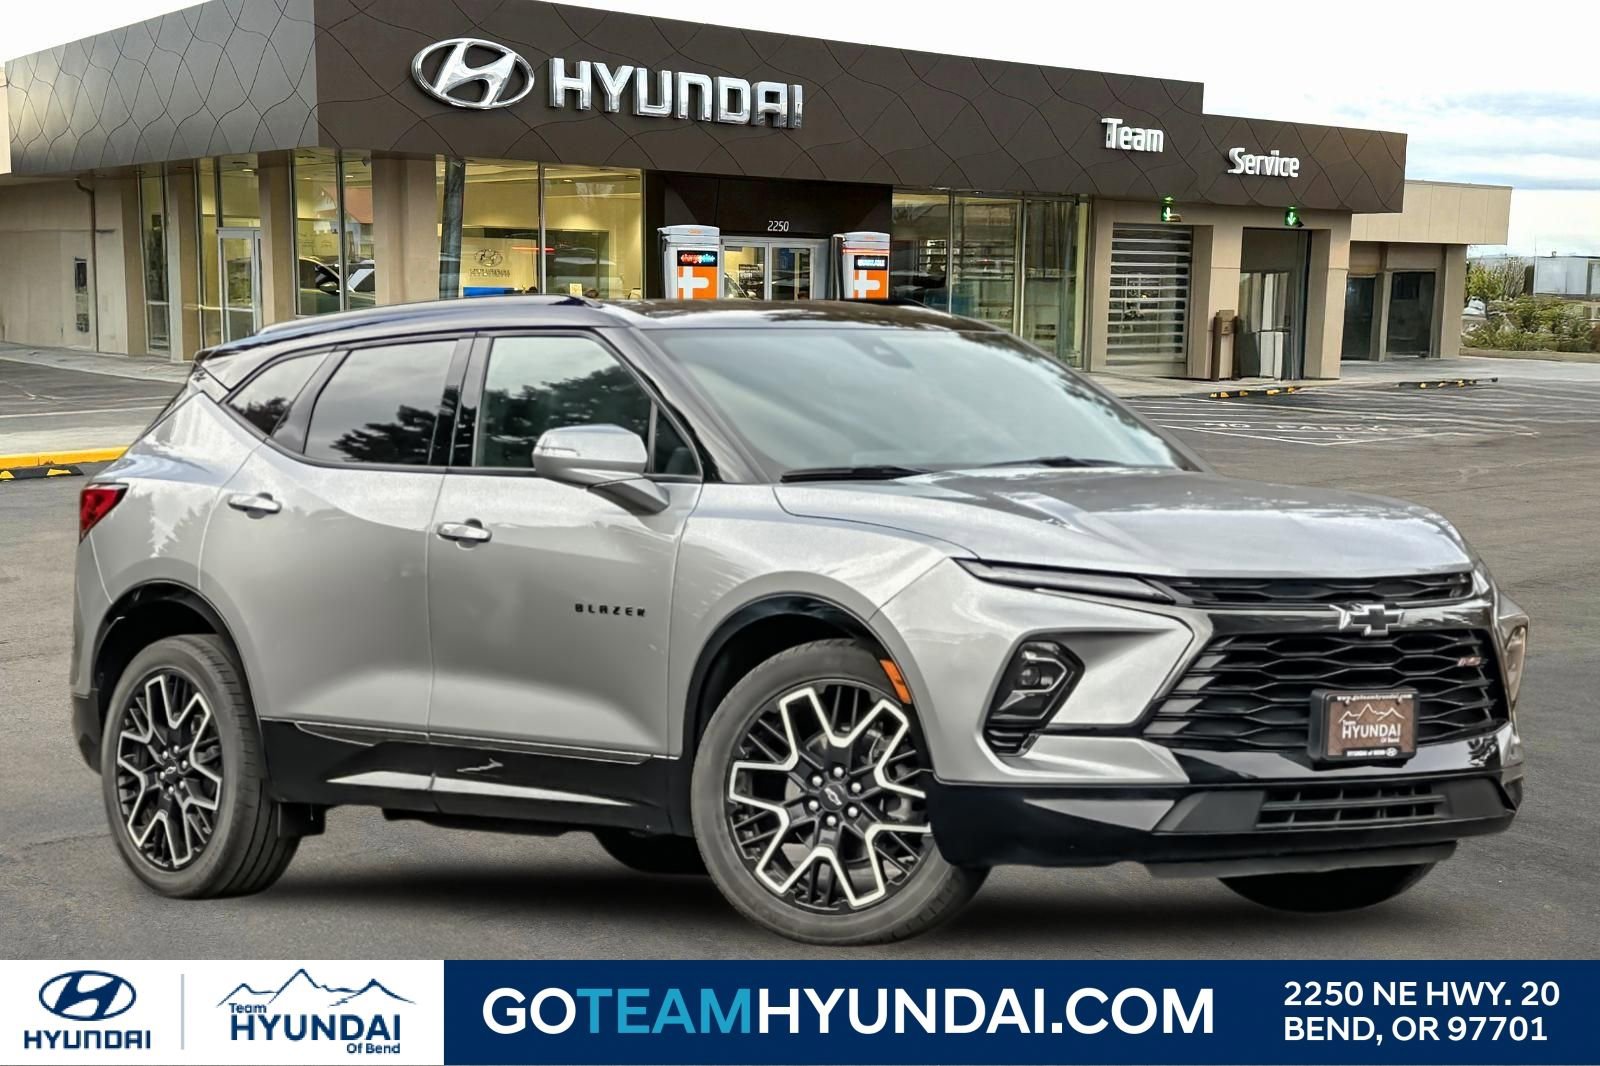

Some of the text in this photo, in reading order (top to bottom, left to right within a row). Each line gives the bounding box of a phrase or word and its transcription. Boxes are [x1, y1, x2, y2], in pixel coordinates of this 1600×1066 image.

[549, 57, 803, 128] HYUNDAI
[1101, 117, 1164, 152] Team
[1227, 147, 1300, 177] Service
[767, 220, 790, 232] 2250
[575, 603, 646, 617] BLAZER
[1342, 723, 1401, 739] HYUNDAI
